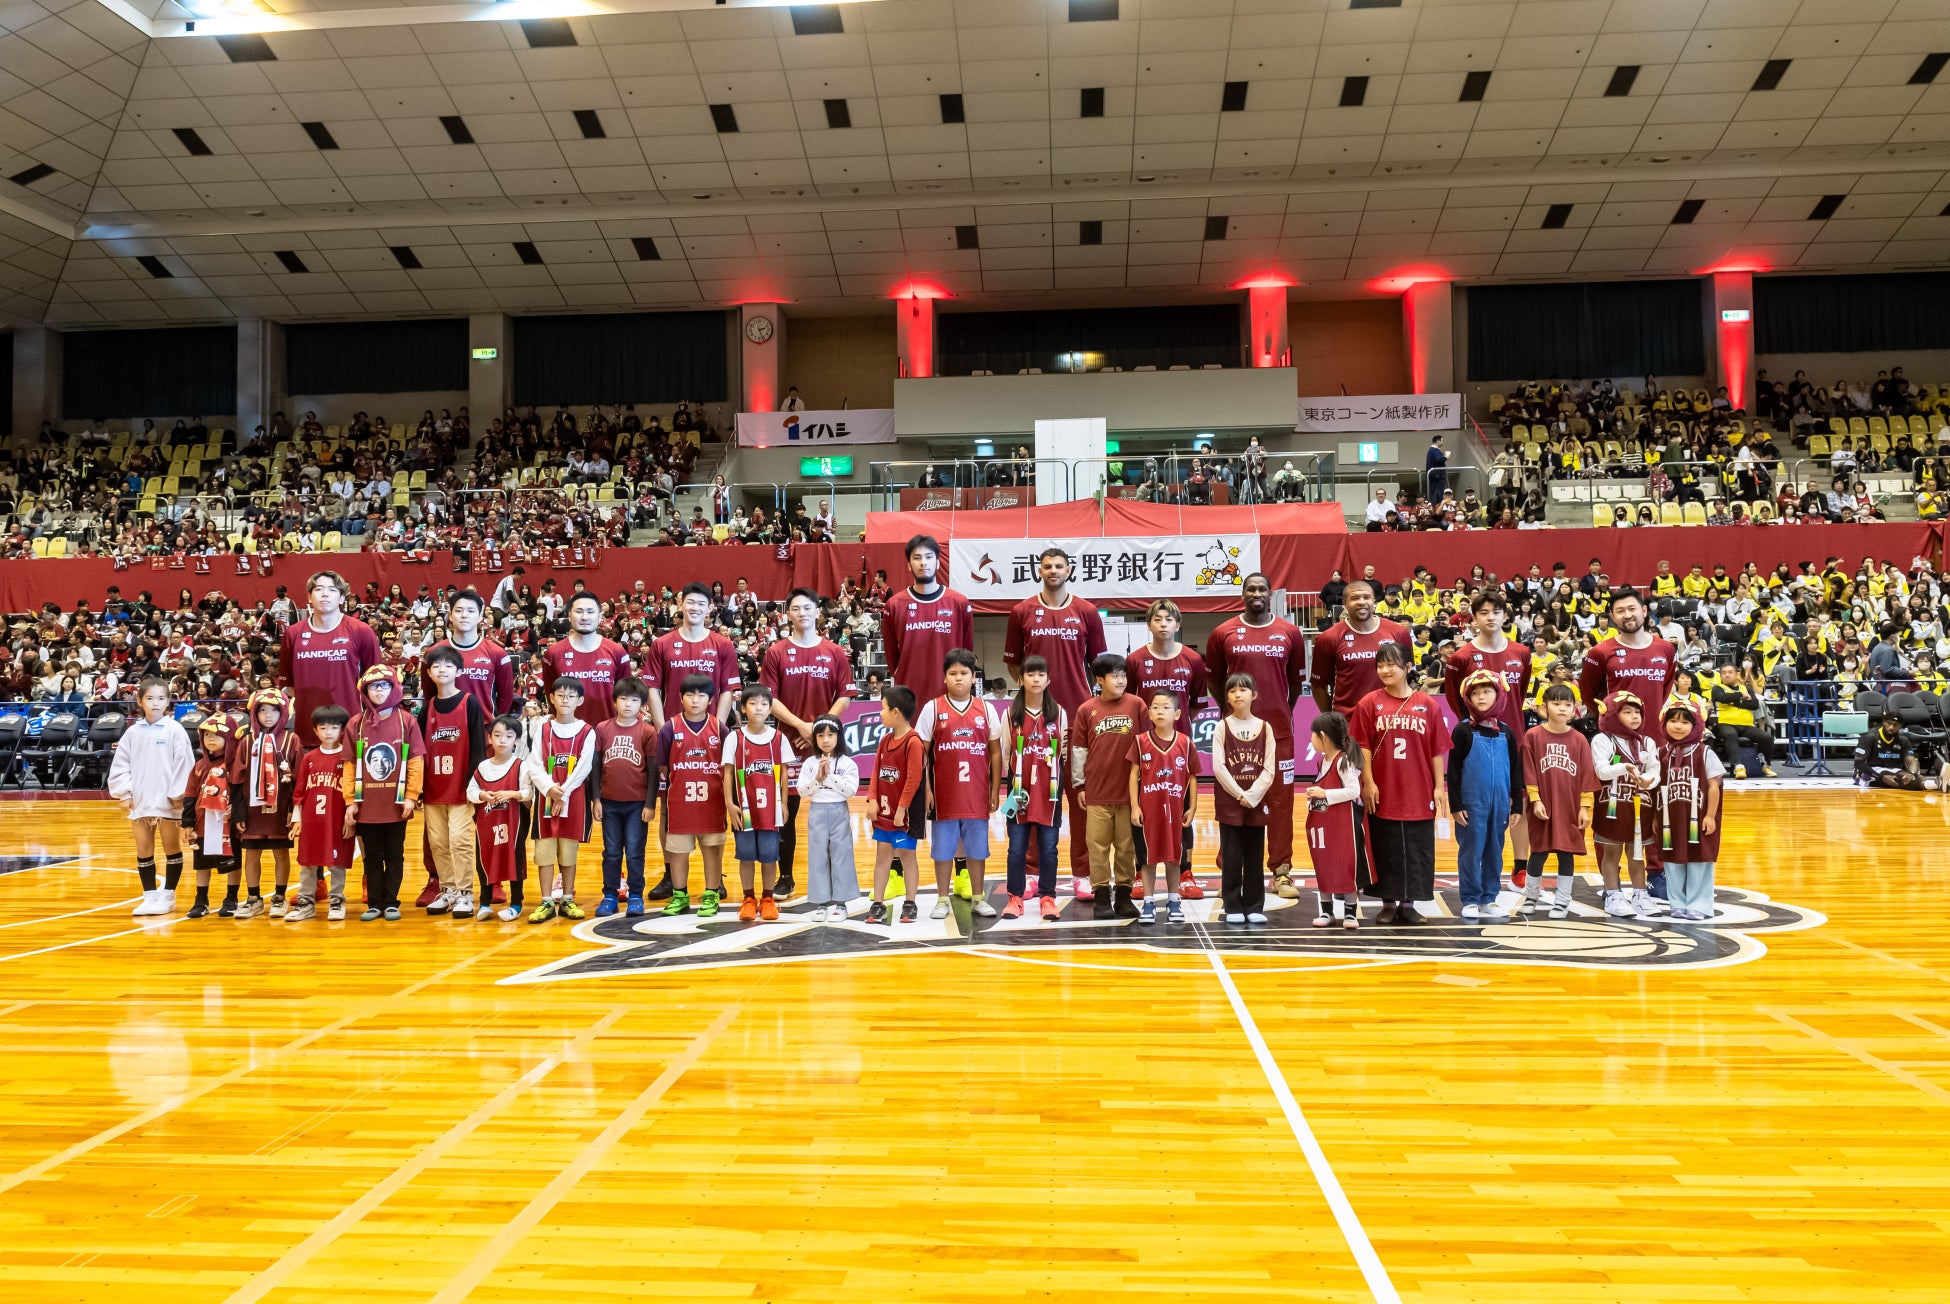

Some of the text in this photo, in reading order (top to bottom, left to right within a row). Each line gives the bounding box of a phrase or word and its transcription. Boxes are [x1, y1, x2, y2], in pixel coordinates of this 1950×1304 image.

[1304, 404, 1449, 421] 東京コーン紙製作所
[906, 620, 951, 630] HANDICAP
[1031, 628, 1078, 636] HANDICAP
[297, 649, 347, 659] HANDICAP
[1233, 645, 1284, 653] HANDICAP
[1343, 651, 1377, 661] HANDI
[671, 659, 715, 668] HANDICAP
[786, 666, 829, 675] HANDICAP
[1615, 669, 1666, 678] HANDICAP
[1143, 679, 1187, 688] HANDICAP
[1094, 718, 1133, 736] ALPHAS
[1376, 716, 1427, 735] ALPHAS
[431, 729, 461, 742] ALPHAS
[612, 735, 635, 749] ALL
[939, 741, 987, 751] HANDICAP
[1393, 737, 1407, 760] 2
[1546, 743, 1569, 757] ALL
[604, 746, 642, 766] ALPHAS
[1228, 752, 1263, 767] ALPHAS
[433, 755, 454, 775] 18
[959, 761, 970, 782] 2
[1540, 753, 1577, 777] ALPHAS
[685, 781, 708, 802] 33
[755, 788, 768, 809] 5
[316, 795, 327, 815] 2
[1310, 827, 1326, 849] 11
